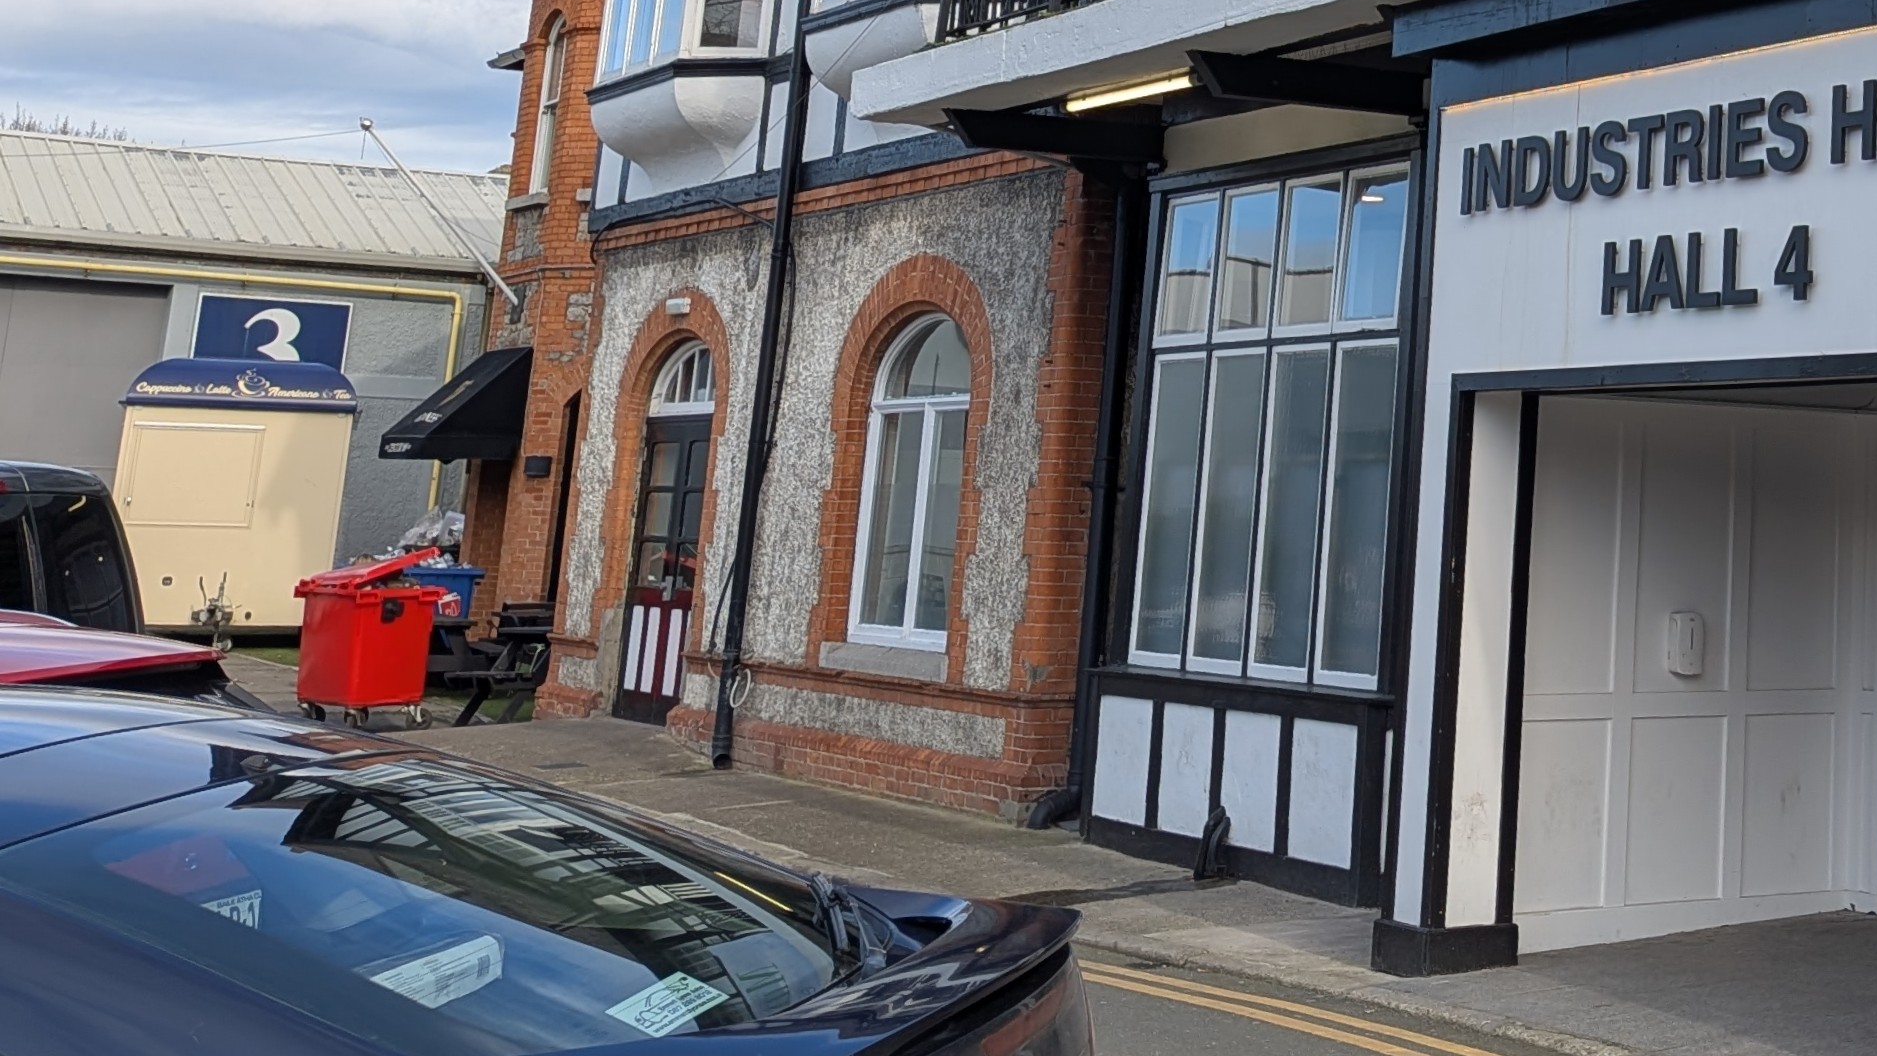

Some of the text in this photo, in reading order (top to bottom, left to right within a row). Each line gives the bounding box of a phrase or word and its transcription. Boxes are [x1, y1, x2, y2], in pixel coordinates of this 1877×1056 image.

[1460, 90, 1809, 216] INDUSTRIES
[1600, 224, 1814, 315] HALL 4
[136, 381, 352, 399] Cappuccino Latte Americano Tea
